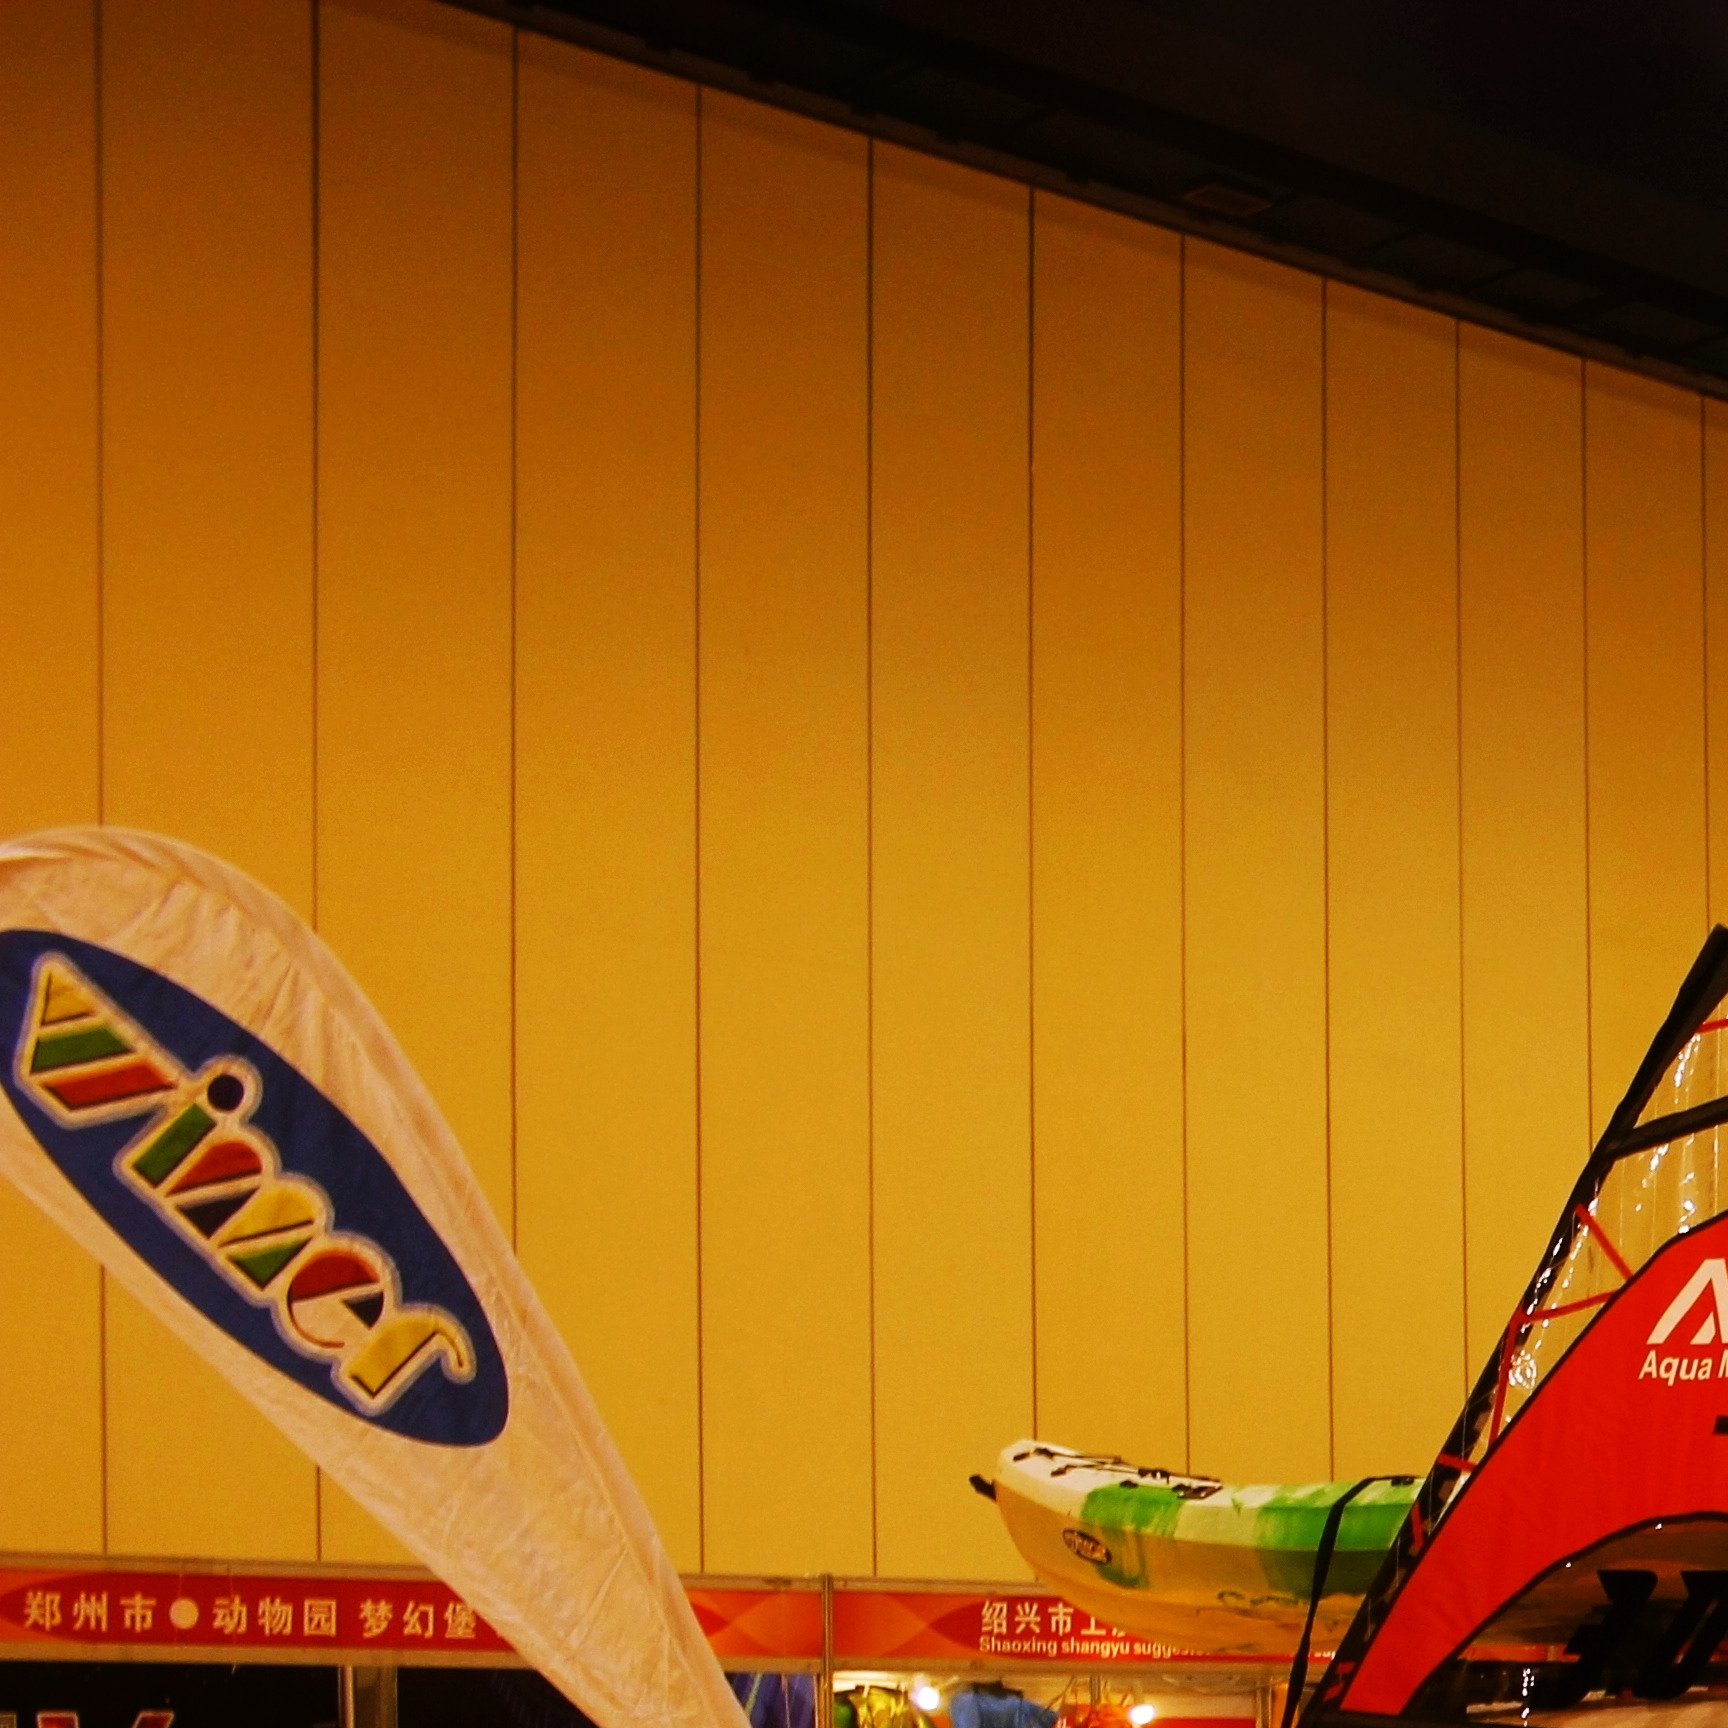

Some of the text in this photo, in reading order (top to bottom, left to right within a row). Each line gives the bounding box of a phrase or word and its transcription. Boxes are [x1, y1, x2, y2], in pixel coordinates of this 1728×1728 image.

[1638, 1349, 1712, 1381] Aqua
[979, 1636, 1058, 1654] Shaoxing
[1061, 1638, 1130, 1659] shangyu
